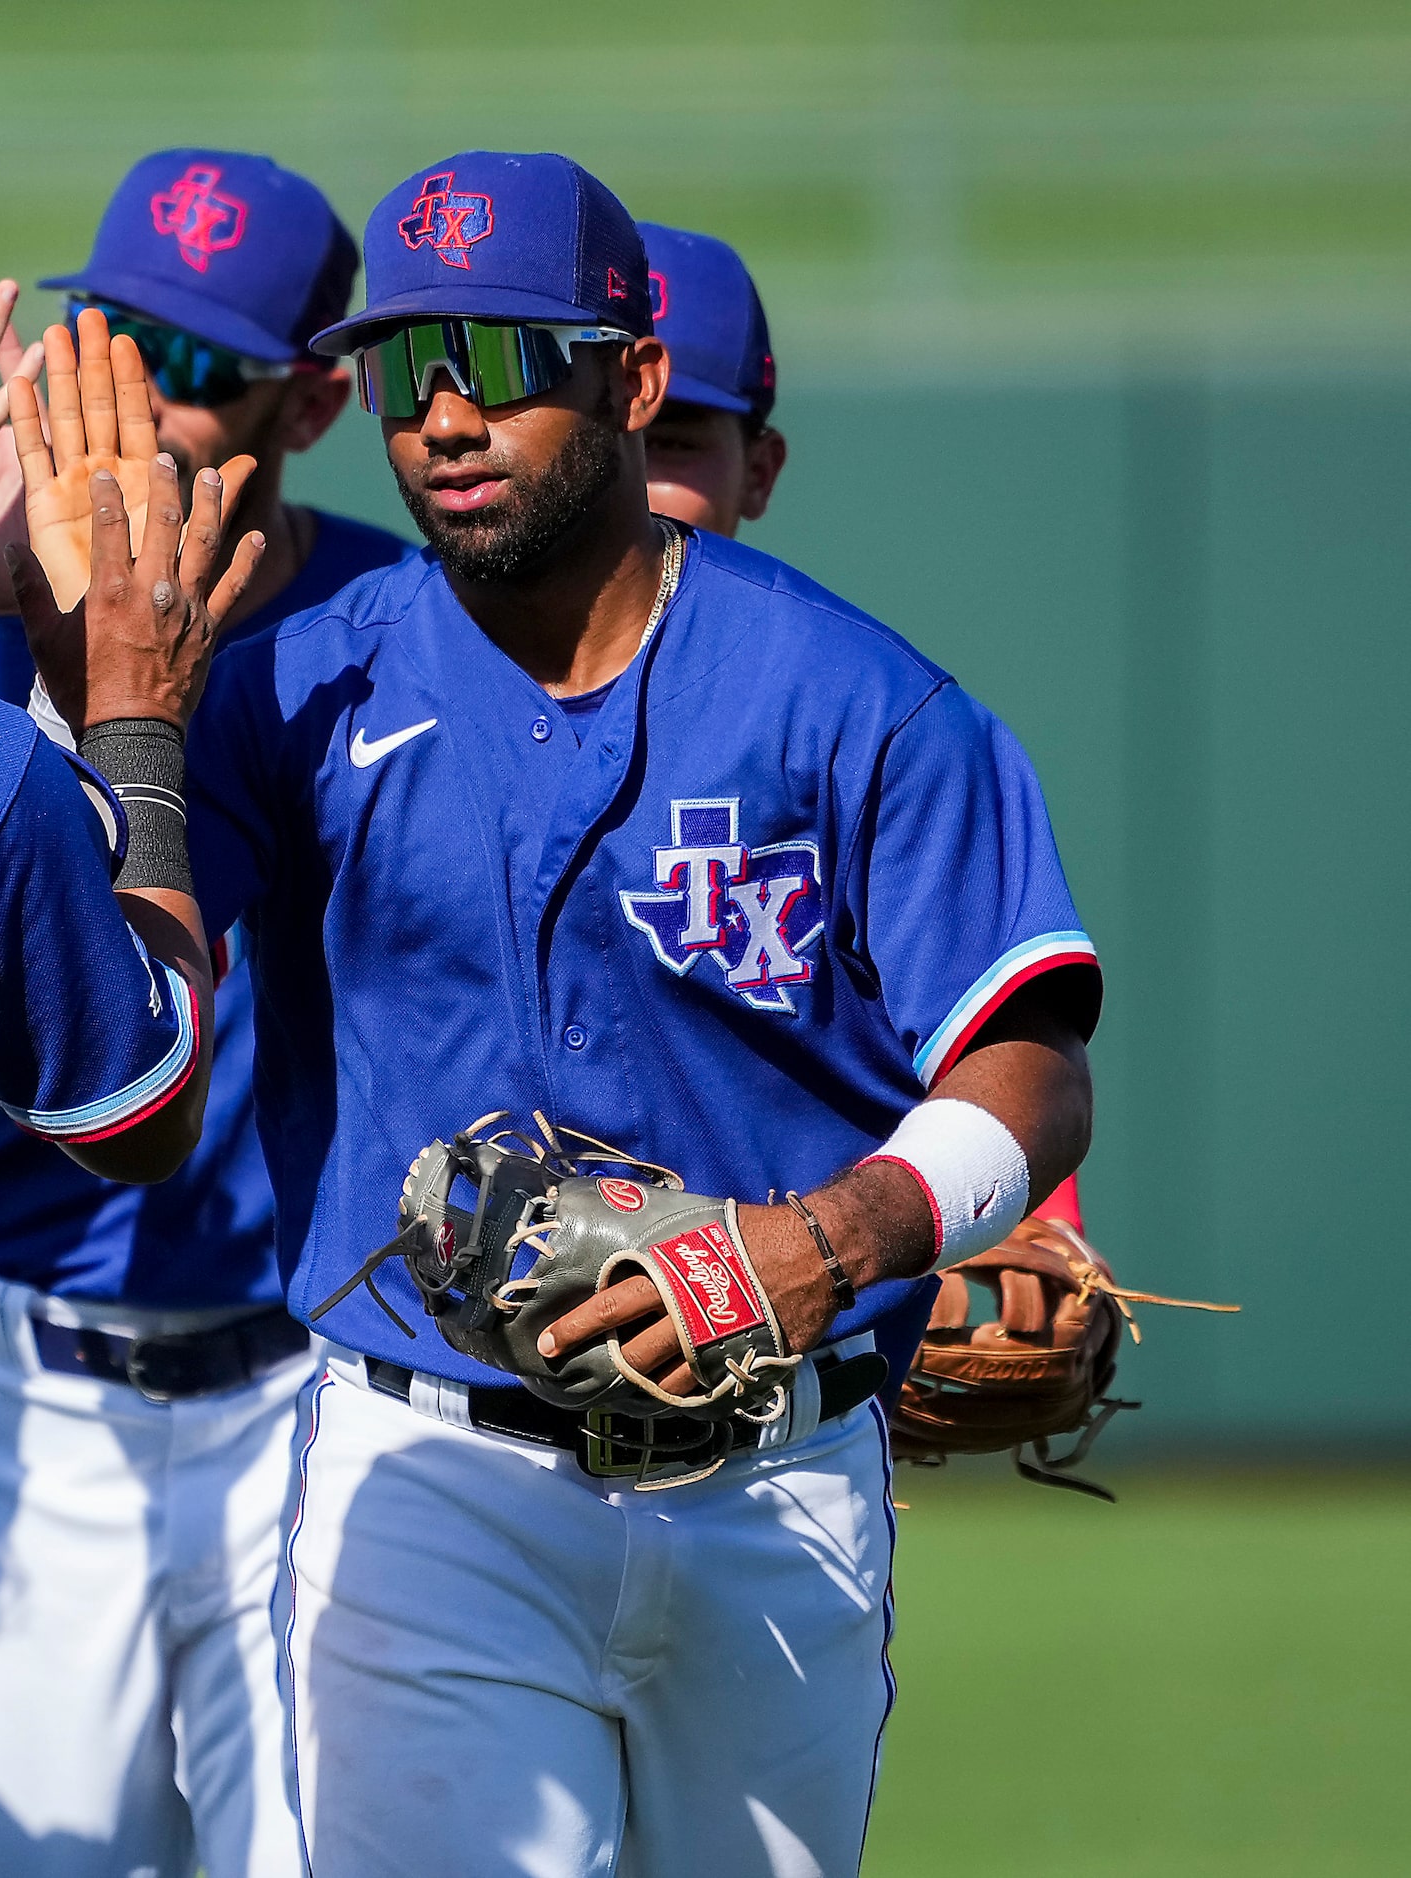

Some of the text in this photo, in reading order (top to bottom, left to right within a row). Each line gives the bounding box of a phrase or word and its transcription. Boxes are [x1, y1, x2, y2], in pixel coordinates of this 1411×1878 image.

[412, 191, 476, 250] TX
[652, 841, 814, 993] TX
[675, 1242, 738, 1324] Rawlings
